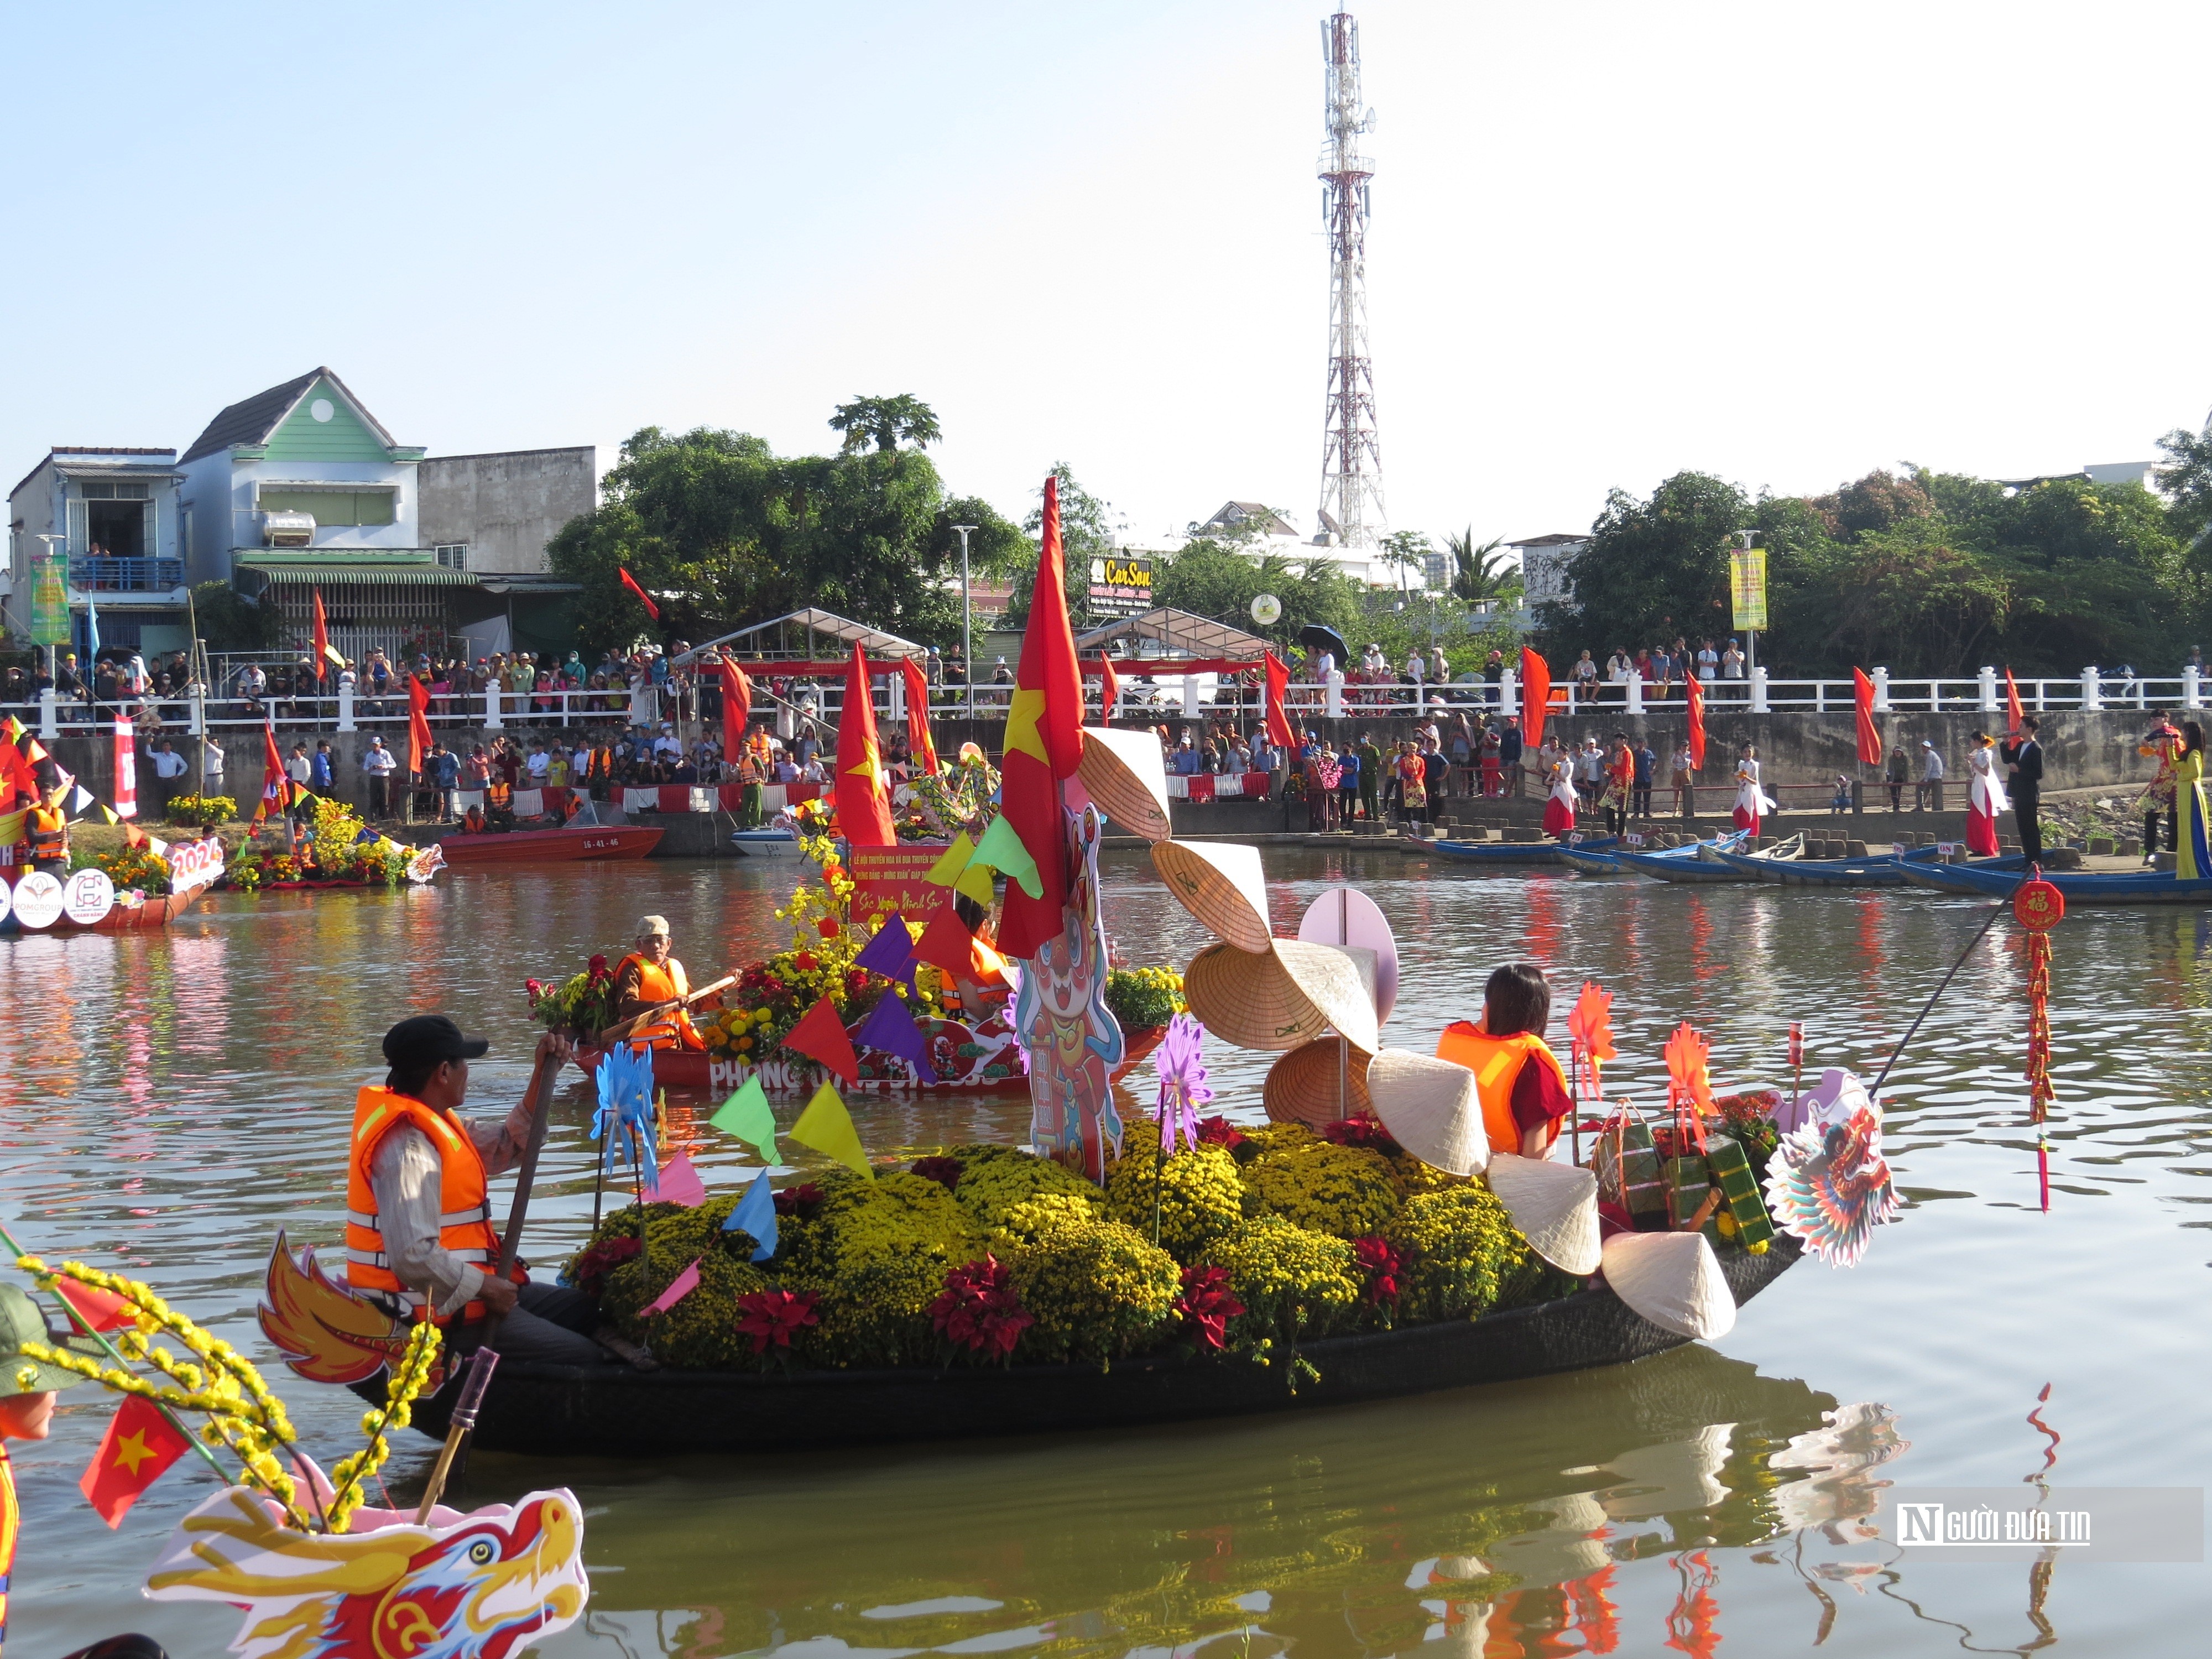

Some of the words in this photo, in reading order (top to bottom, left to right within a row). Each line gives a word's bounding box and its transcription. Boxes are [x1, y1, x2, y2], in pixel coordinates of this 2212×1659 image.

[1107, 560, 1151, 587] CarSon
[1735, 841, 1745, 850] 10
[173, 840, 223, 878] 2024
[2027, 891, 2049, 912] 福
